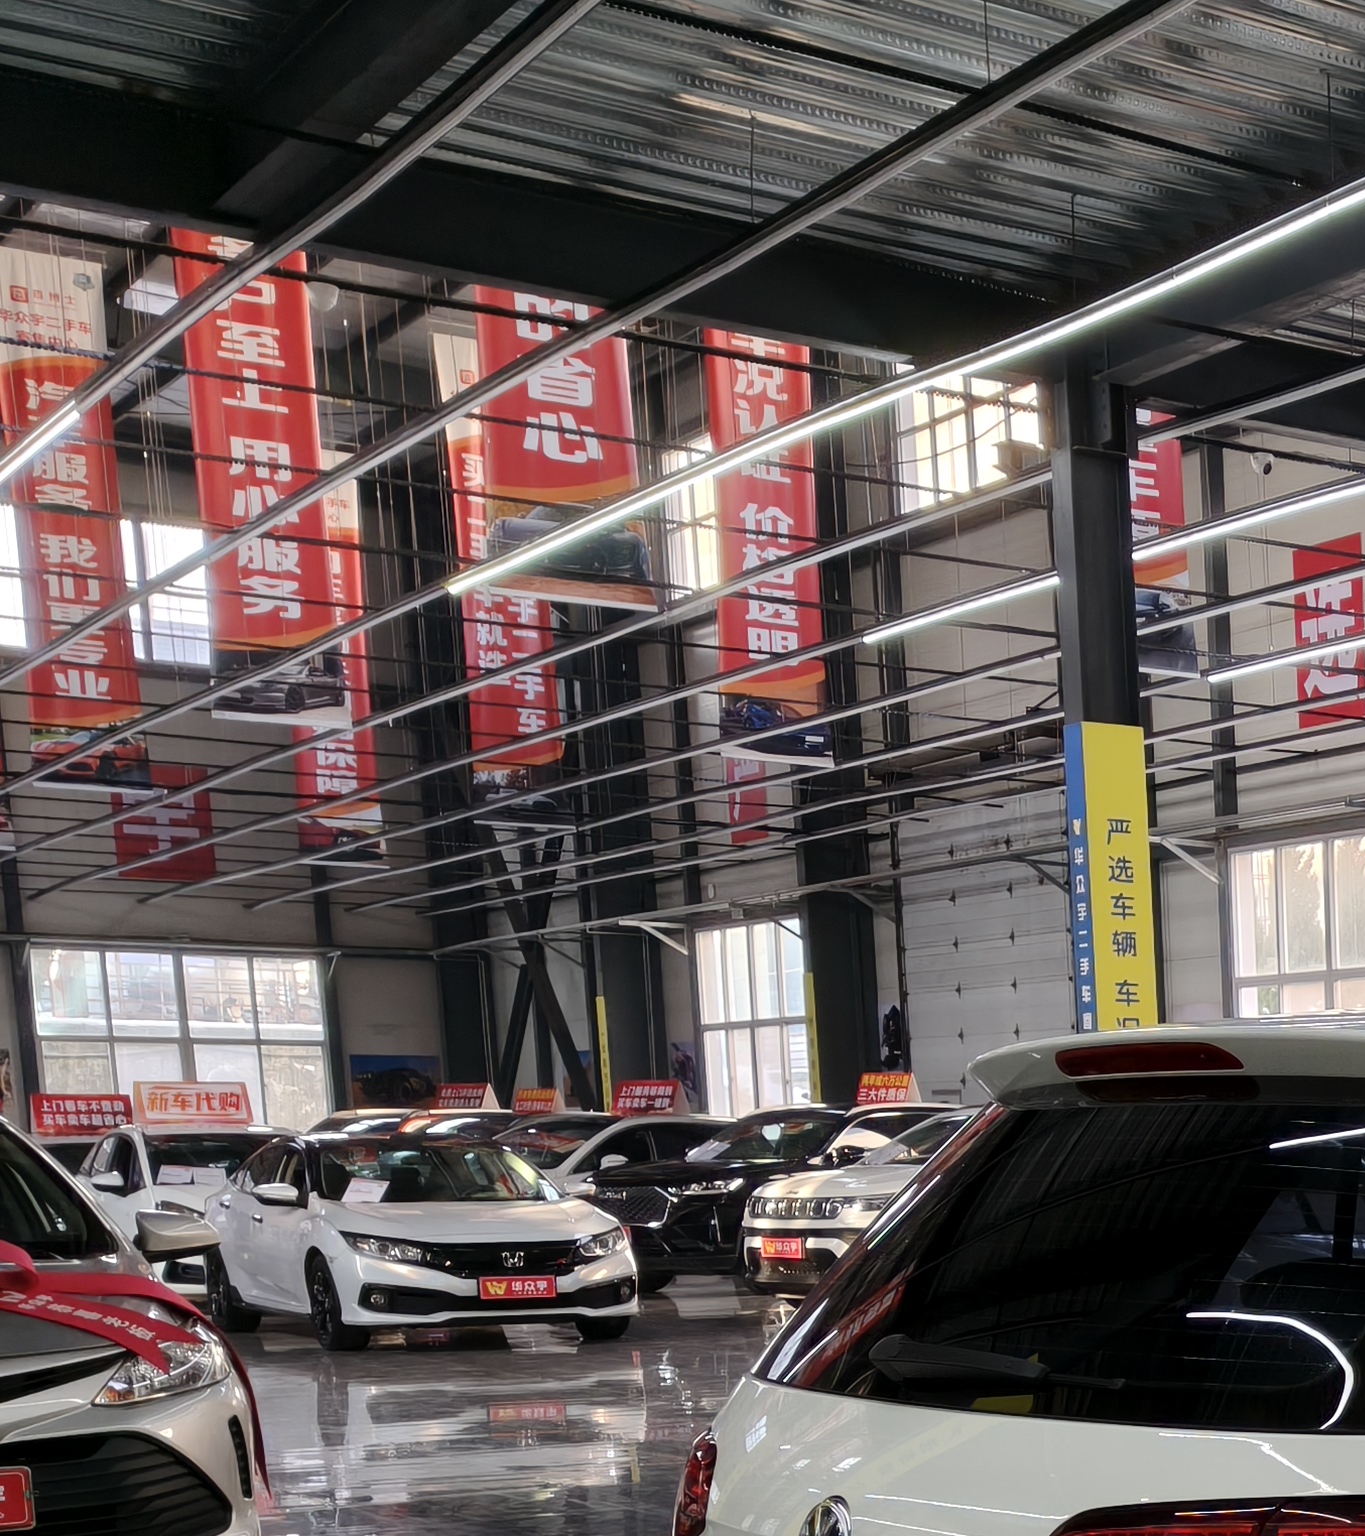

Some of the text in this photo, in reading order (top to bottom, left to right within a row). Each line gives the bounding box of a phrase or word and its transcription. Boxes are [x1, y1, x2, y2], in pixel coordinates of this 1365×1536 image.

[739, 503, 800, 666] 价格透明
[1106, 818, 1138, 958] 严选车辆
[147, 1091, 242, 1113] 新车代购
[857, 1087, 907, 1101] 三大件质保
[511, 1280, 548, 1292] 华众宇
